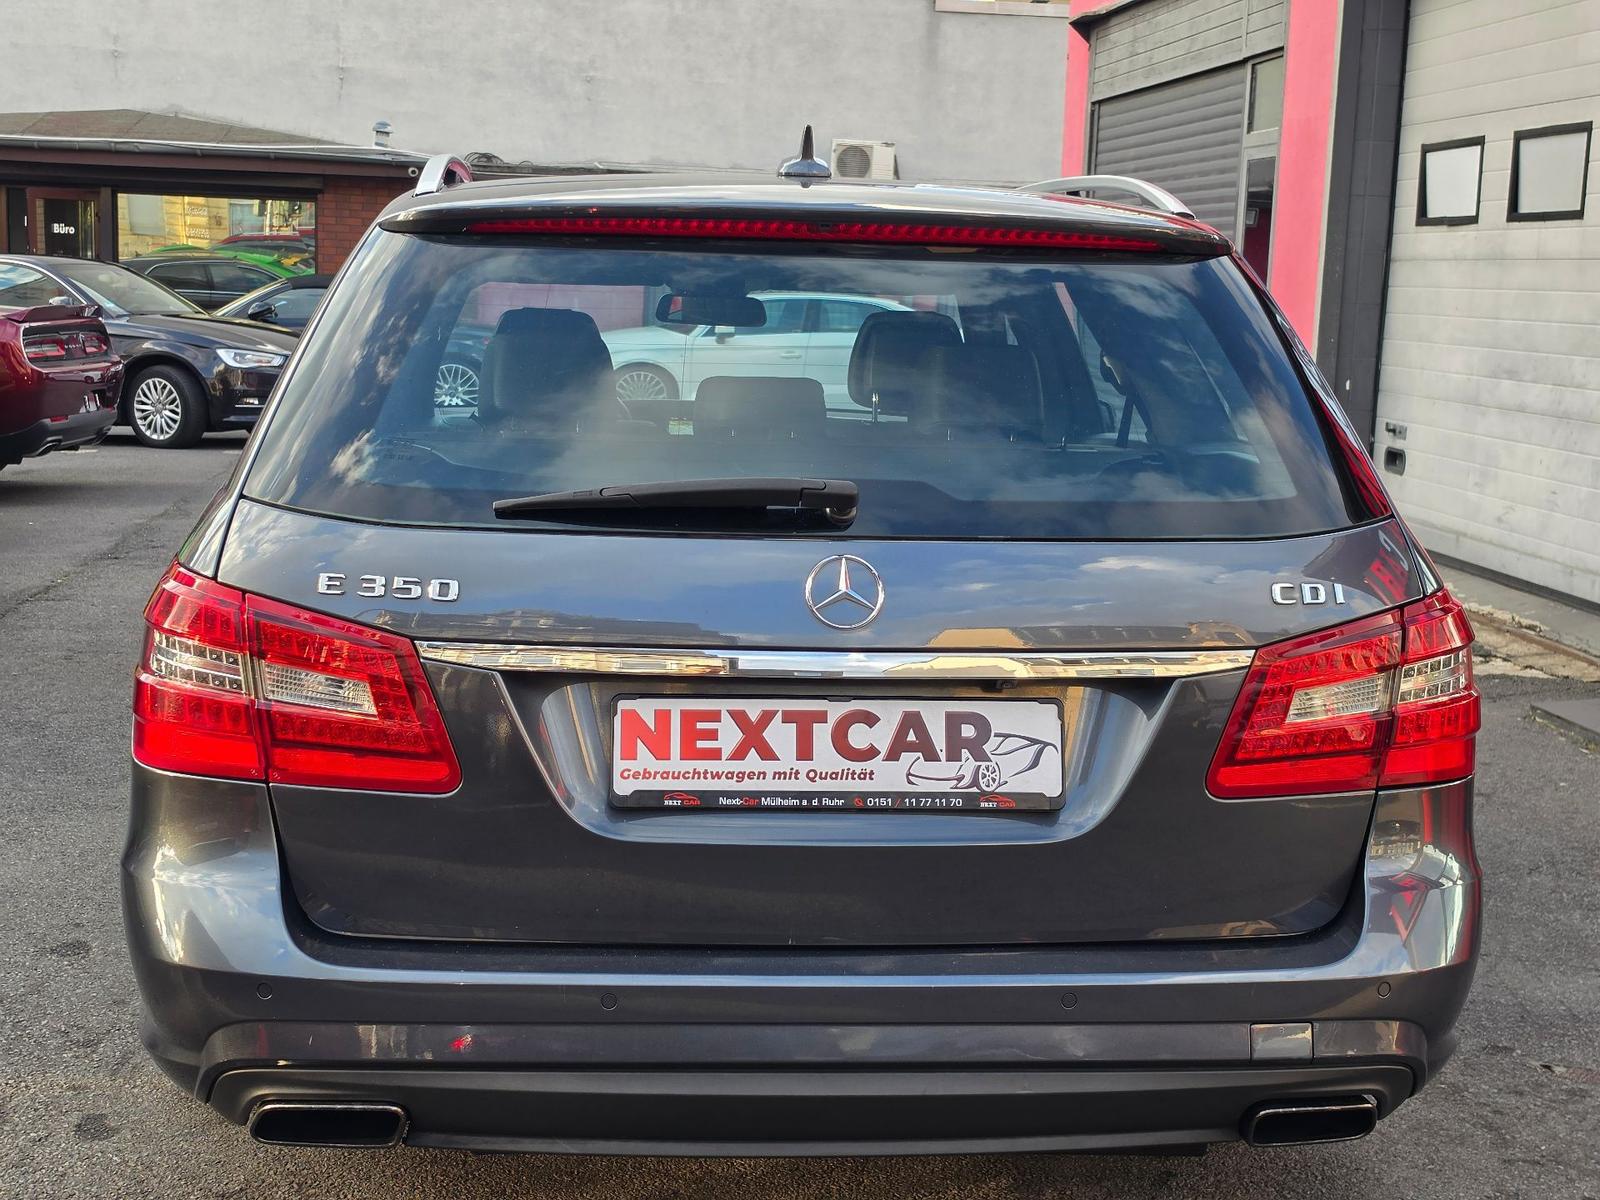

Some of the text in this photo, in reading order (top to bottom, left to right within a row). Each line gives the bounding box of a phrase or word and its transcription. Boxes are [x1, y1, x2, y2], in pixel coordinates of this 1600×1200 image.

[53, 223, 75, 234] Büro
[318, 573, 460, 601] E 350
[1271, 582, 1346, 604] CDI
[619, 708, 992, 763] NEXTCAR
[619, 767, 875, 783] Gebrauchtwagen mit Qualität
[719, 797, 759, 806] Next-Car
[761, 797, 800, 806] Mülheim
[822, 797, 845, 806] Ruhr
[867, 798, 892, 806] 0151
[904, 799, 917, 807] 11
[919, 799, 931, 807] 77
[934, 799, 947, 807] 11
[949, 799, 963, 807] 70
